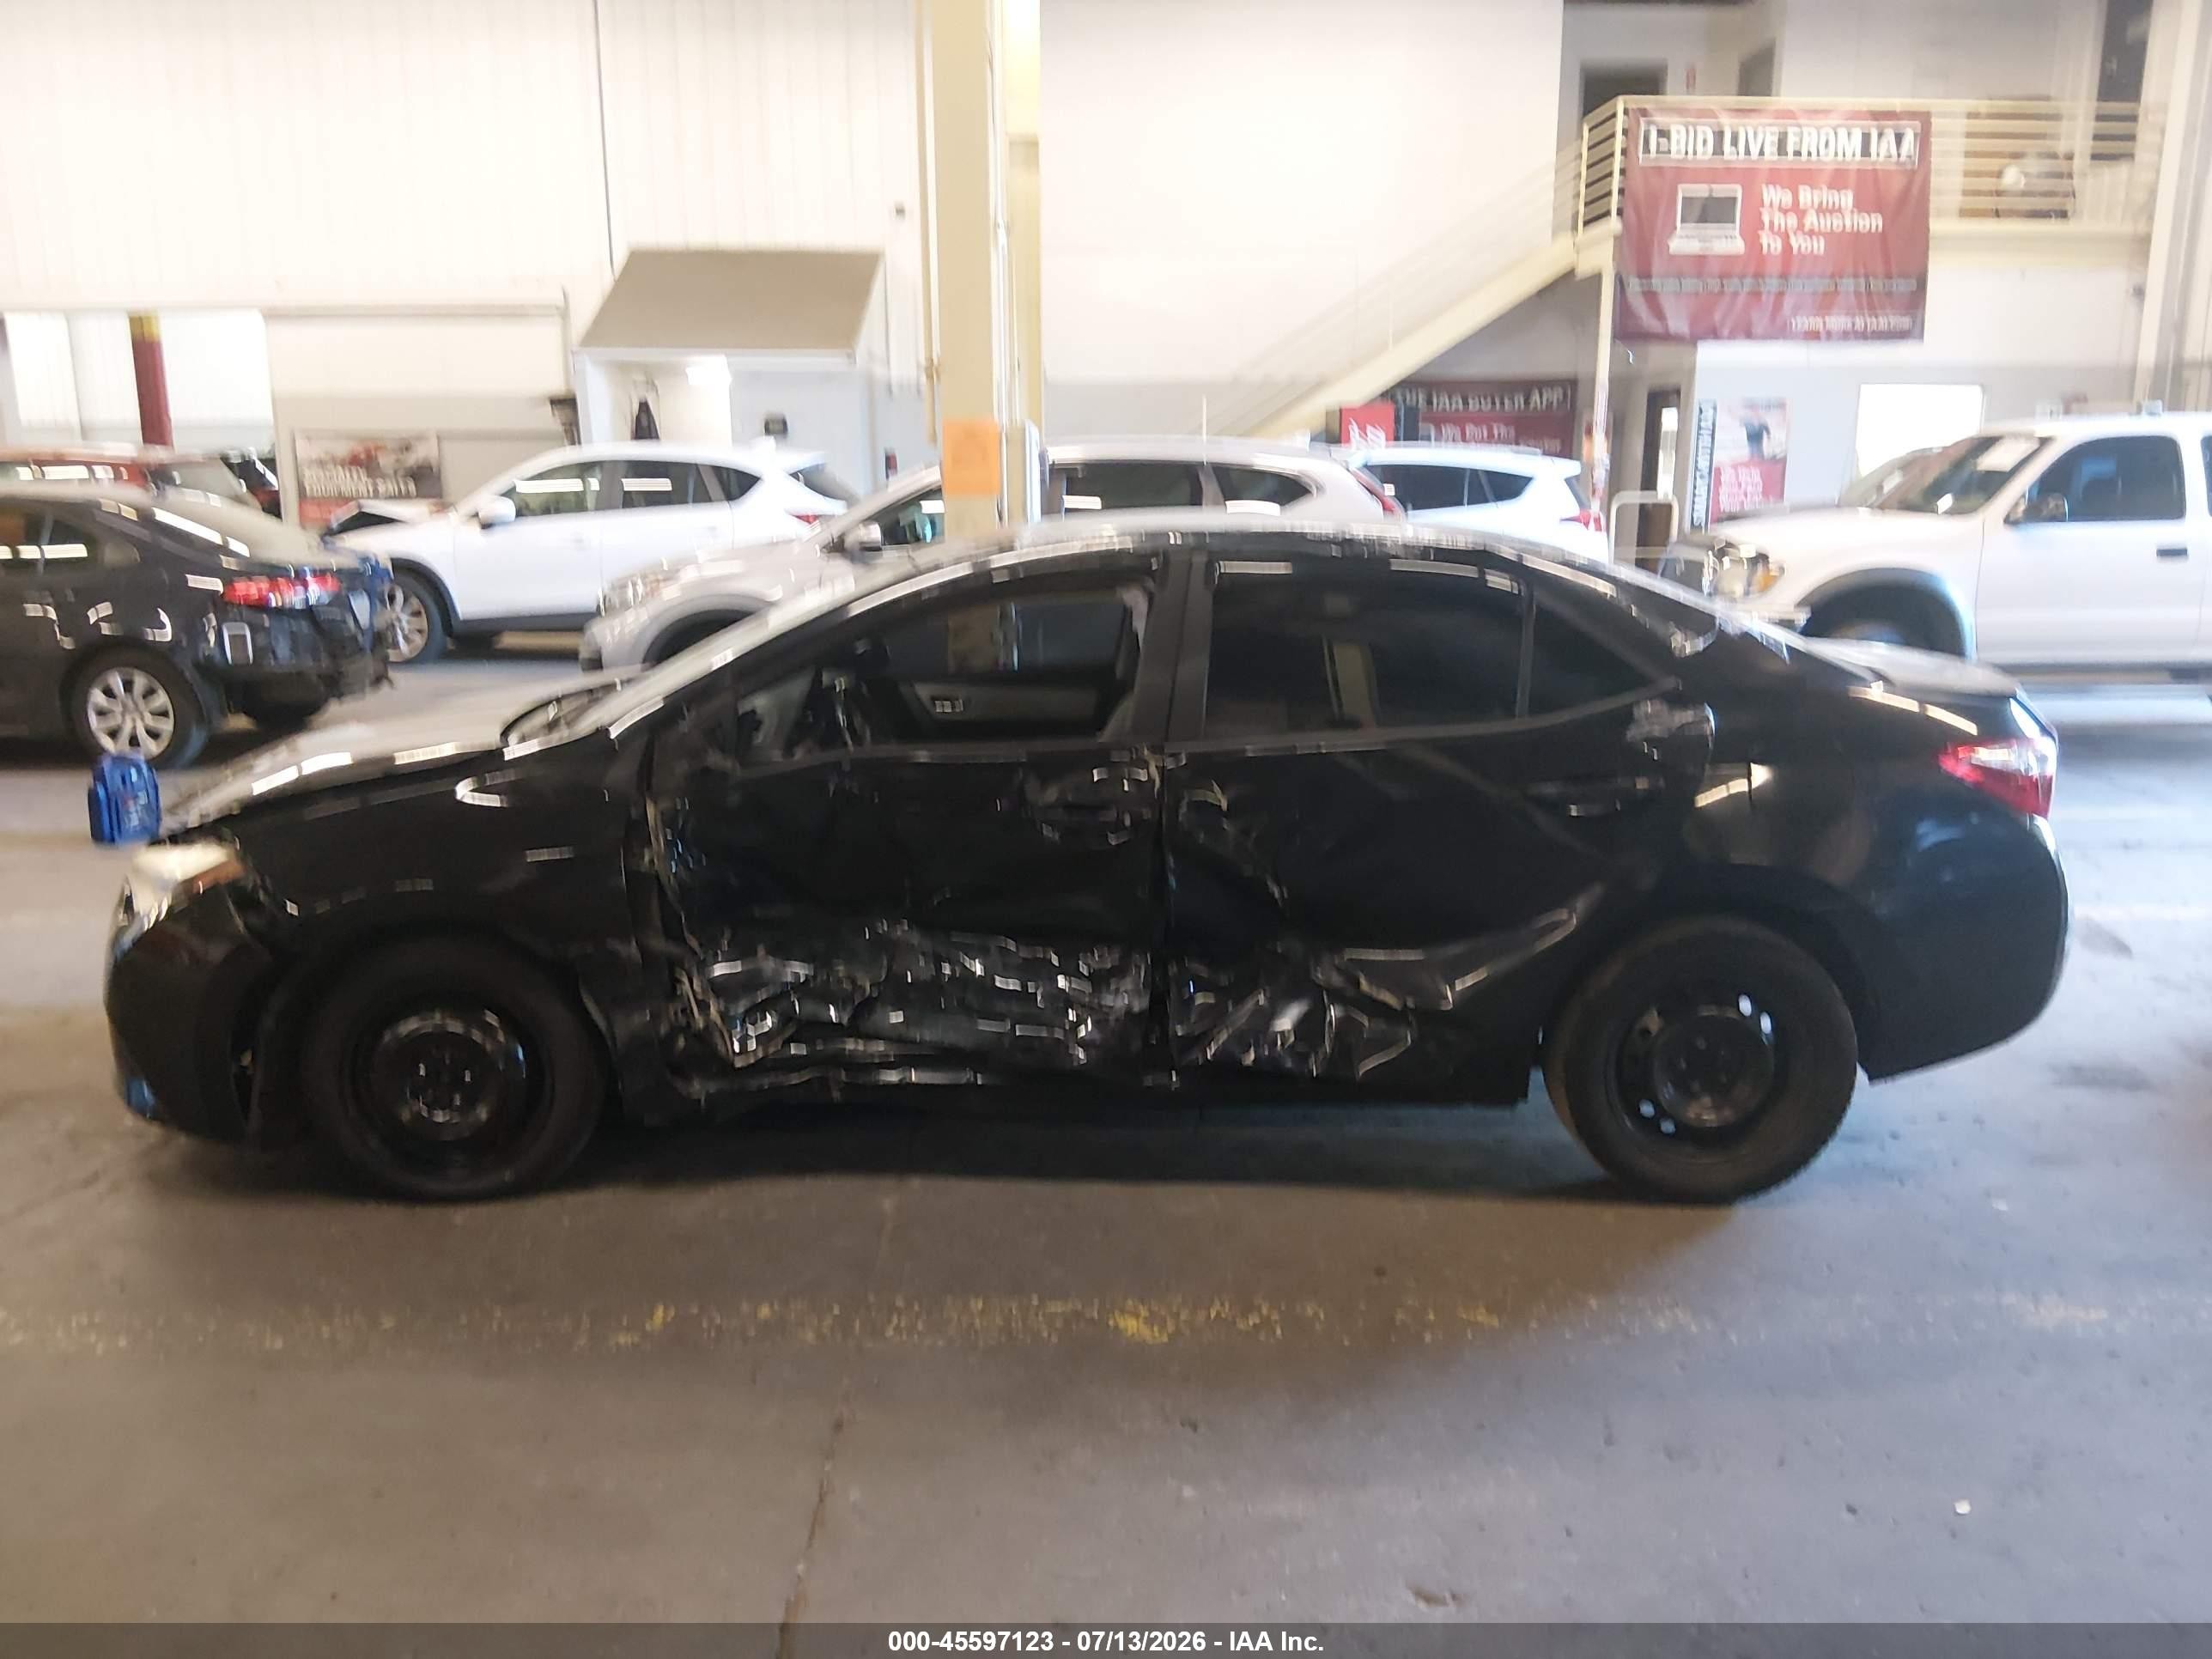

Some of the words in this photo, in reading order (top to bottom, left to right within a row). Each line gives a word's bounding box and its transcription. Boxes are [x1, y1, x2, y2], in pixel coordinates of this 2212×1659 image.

[1649, 125, 1714, 161] I-BID
[1723, 125, 1779, 161] LIVE
[1786, 125, 1863, 161] FROM
[1869, 126, 1916, 162] IAA
[1761, 184, 1793, 210] We
[1798, 184, 1854, 210] Bring
[1759, 207, 1798, 233] The
[1803, 208, 1883, 233] Auction
[1758, 229, 1783, 255] To
[1787, 230, 1825, 255] You
[1528, 386, 1564, 411] APP
